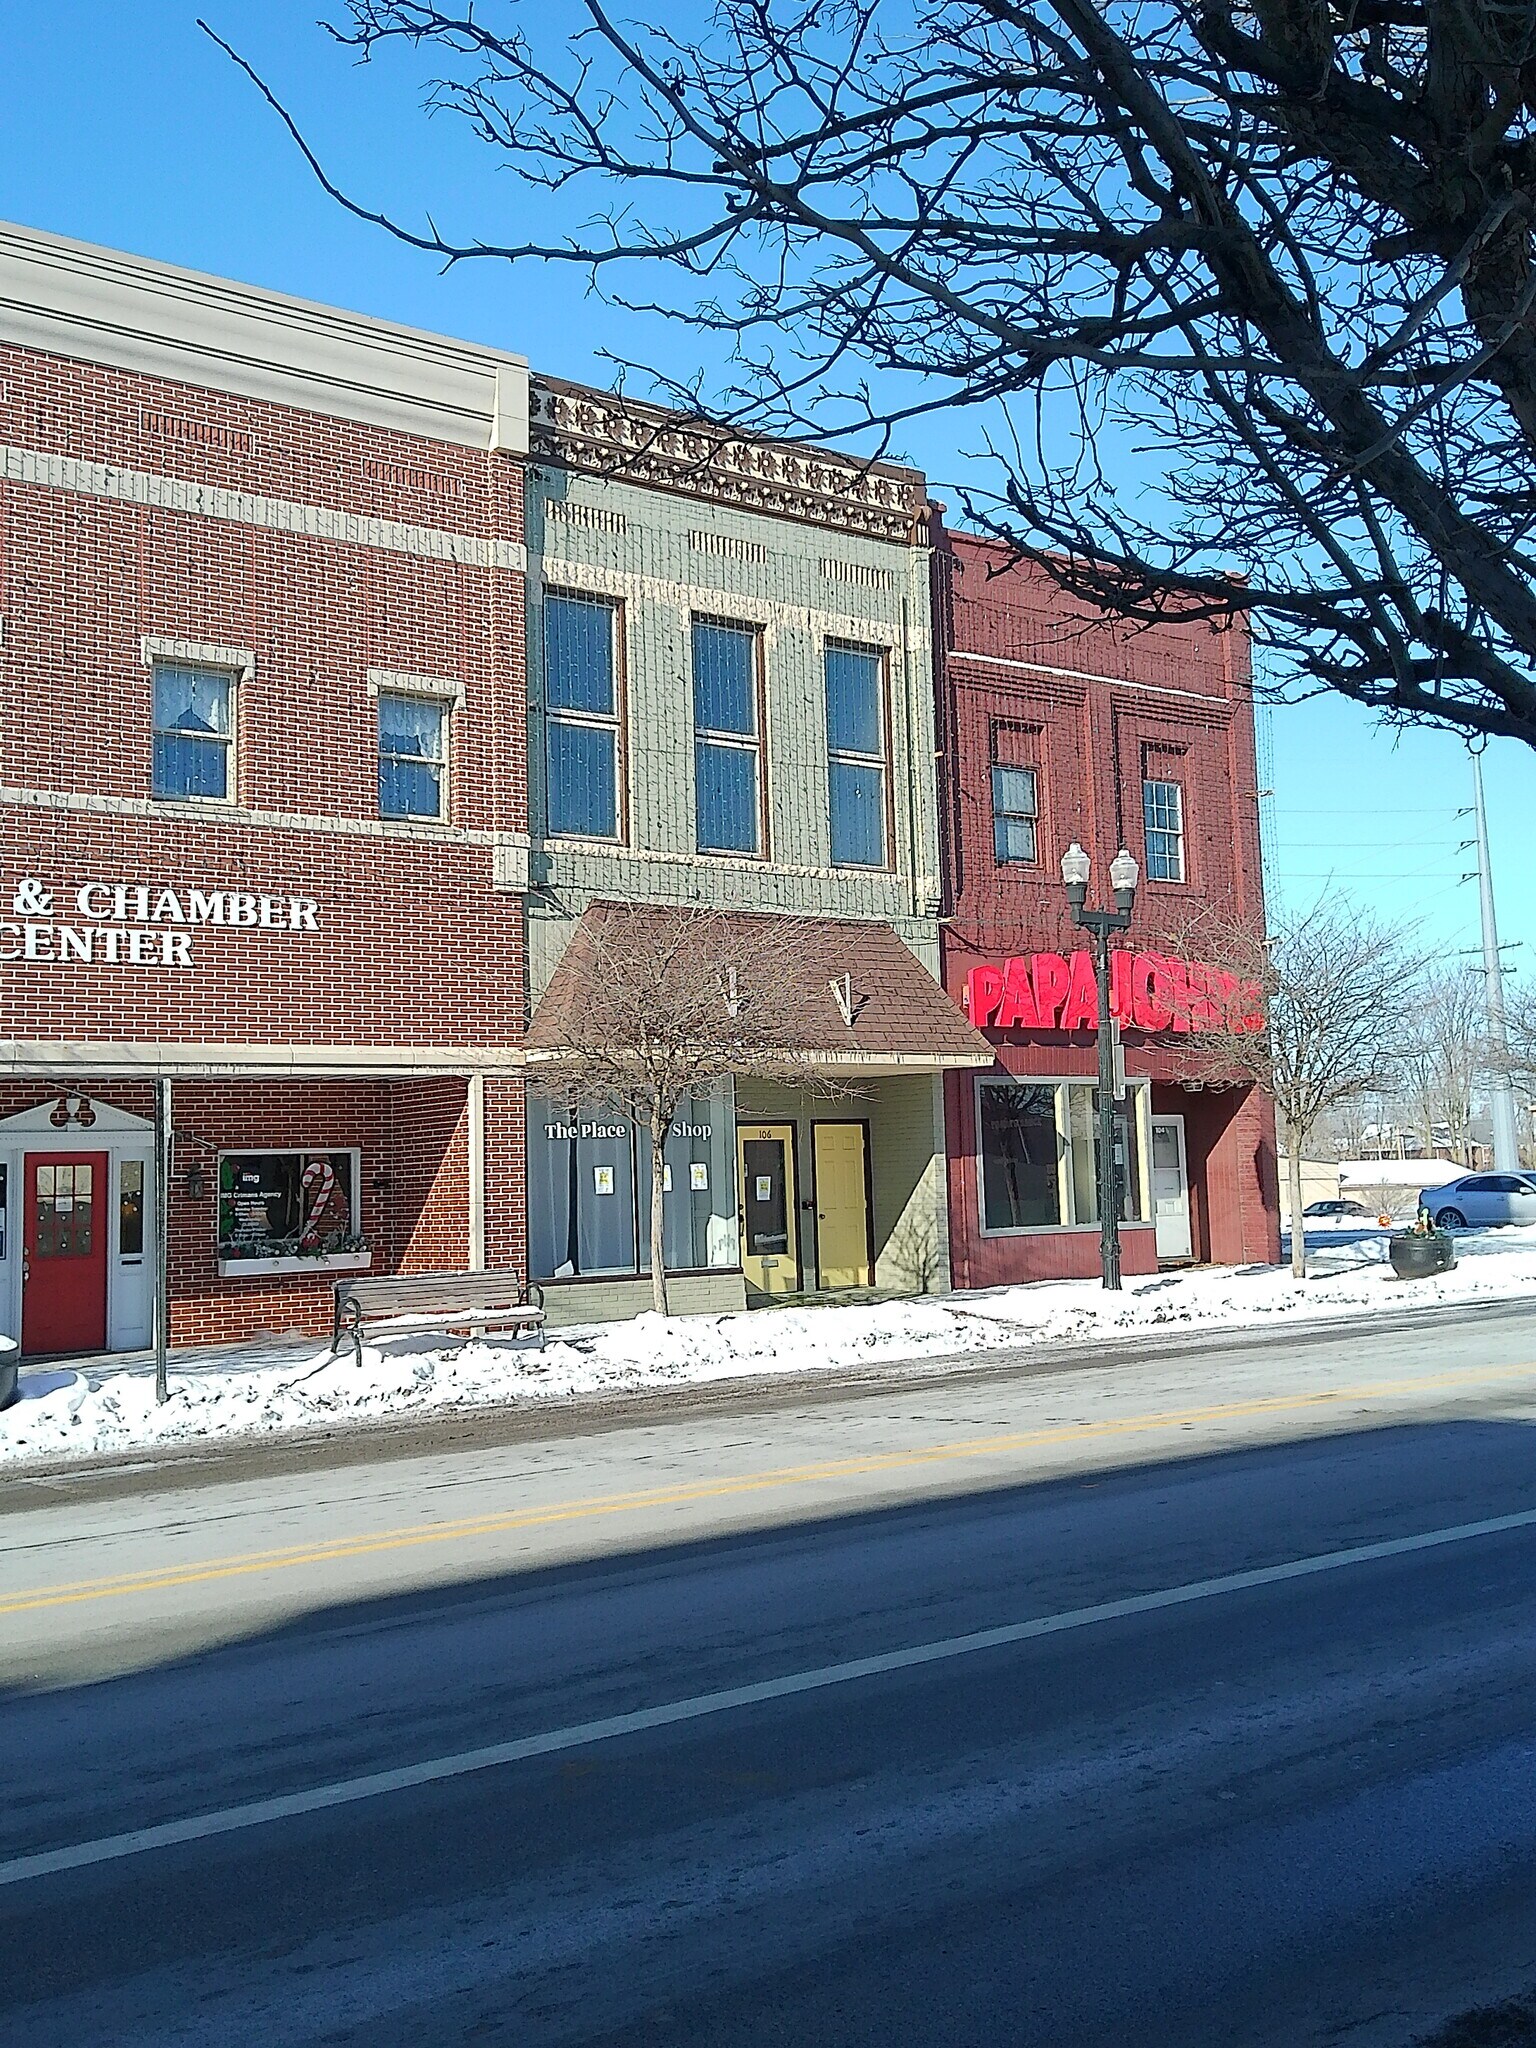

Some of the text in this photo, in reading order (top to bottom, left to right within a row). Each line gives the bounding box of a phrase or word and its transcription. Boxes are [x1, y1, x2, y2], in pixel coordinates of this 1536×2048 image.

[13, 879, 320, 930] & CHAMBER
[0, 922, 195, 967] CENTER
[967, 949, 1266, 1033] PAPA JOHN
[544, 1120, 712, 1141] The Place Shop
[758, 1130, 772, 1139] 106
[242, 1172, 260, 1183] img
